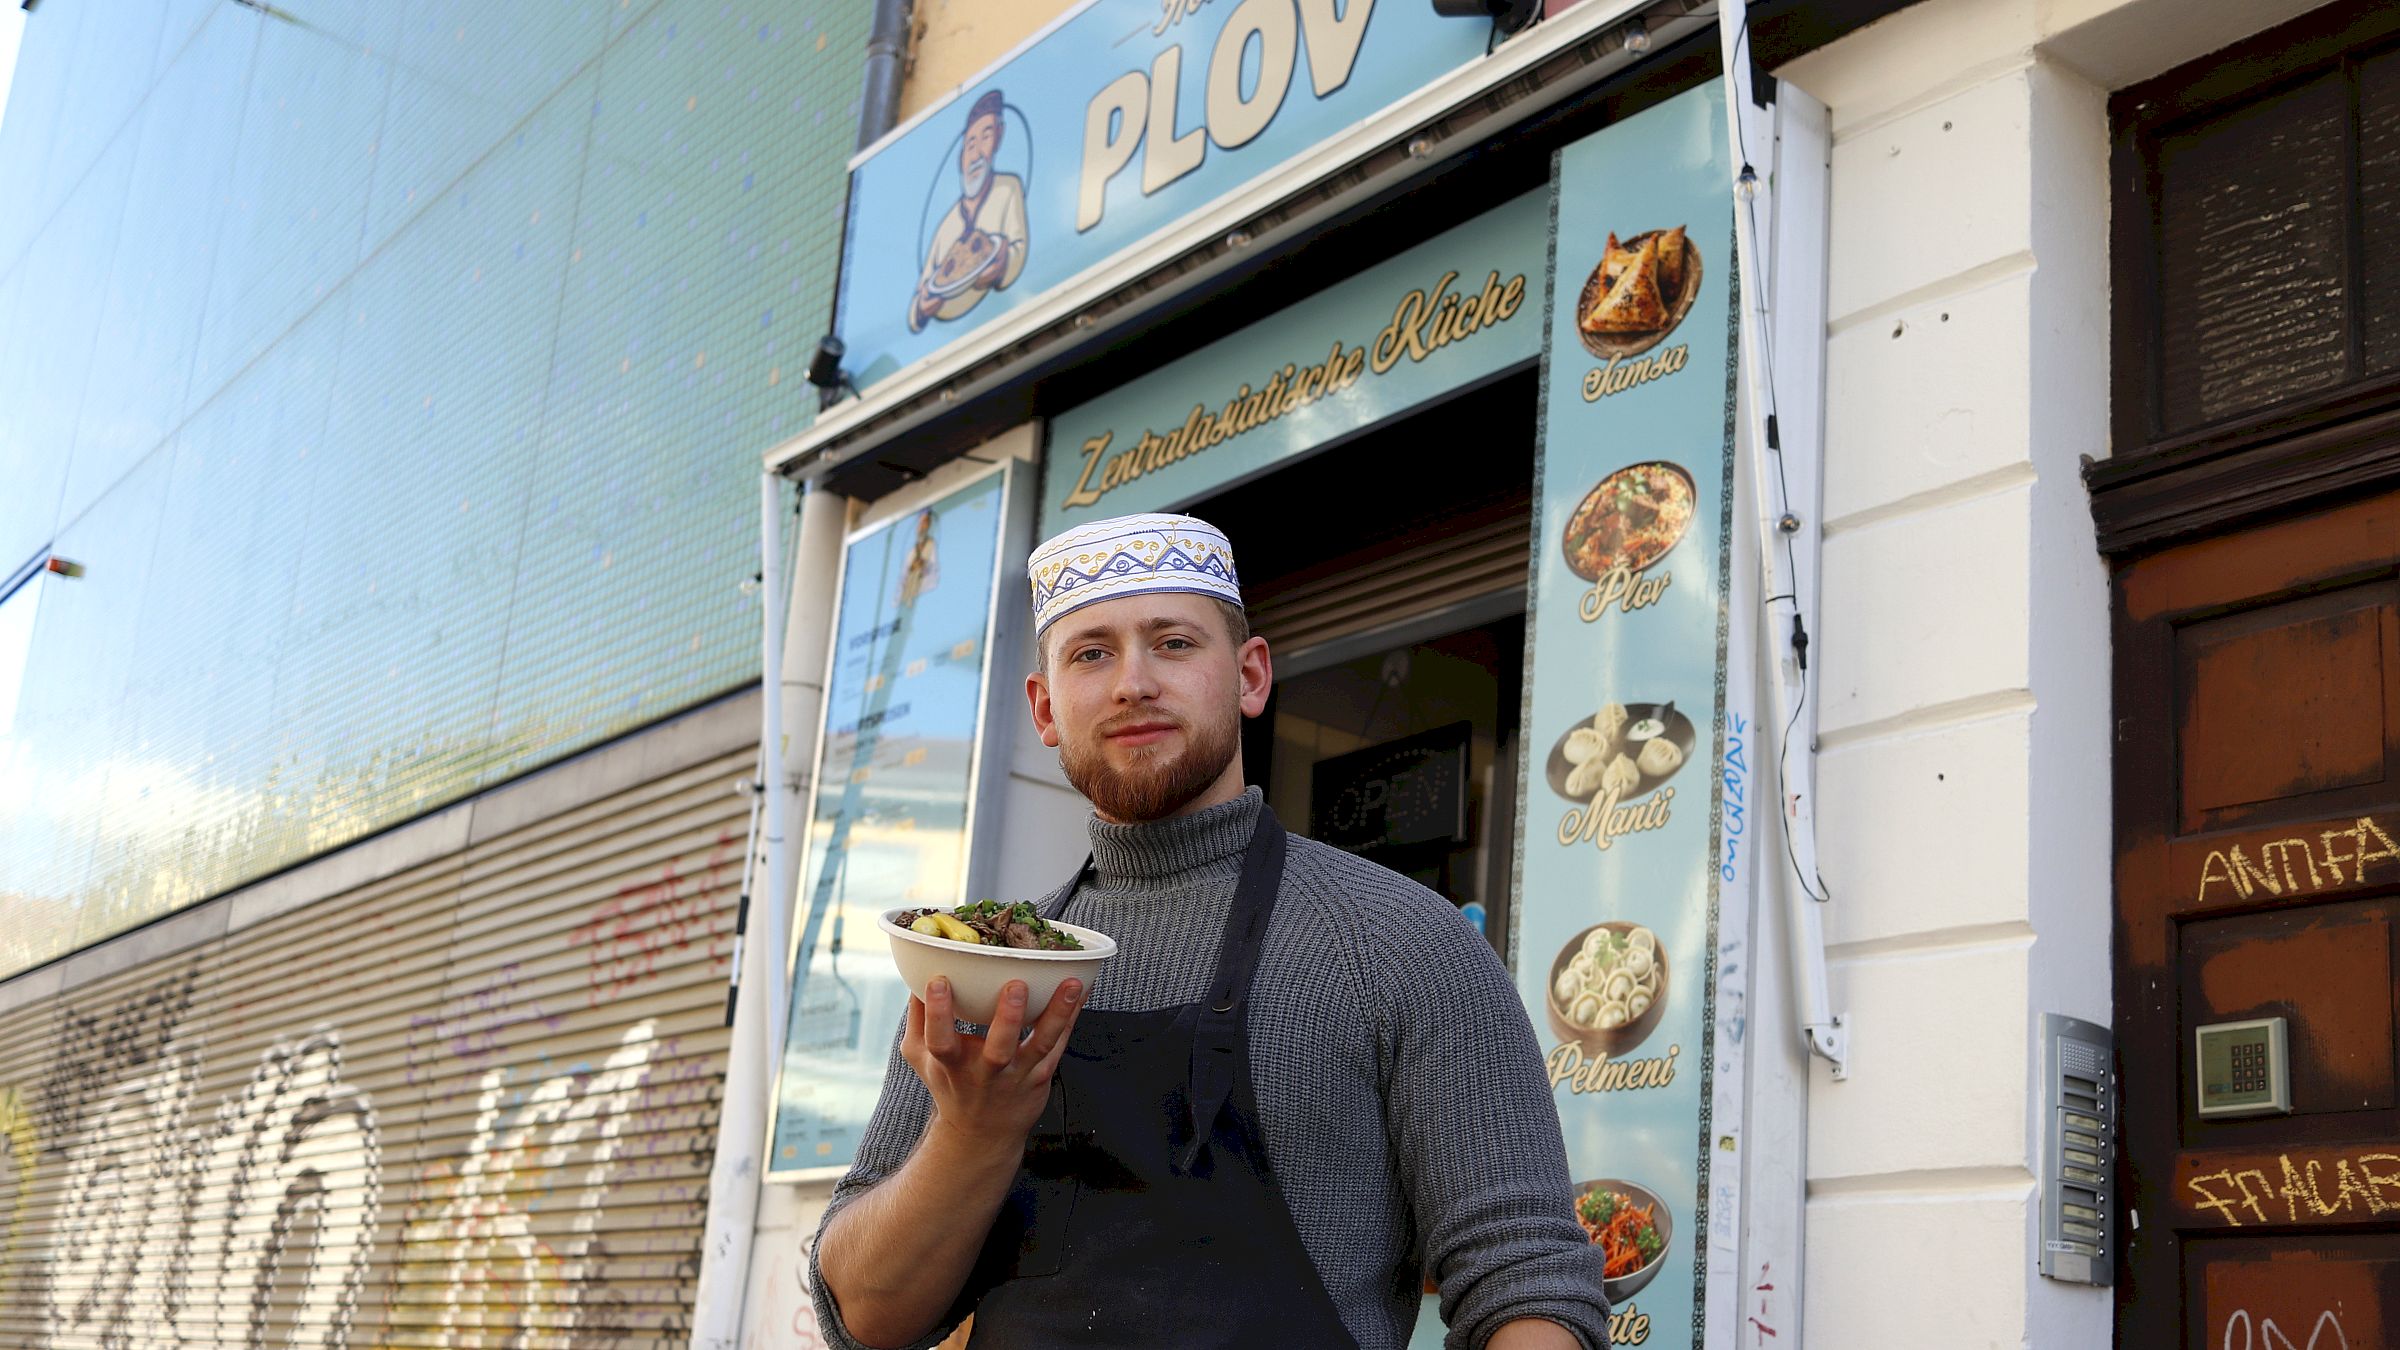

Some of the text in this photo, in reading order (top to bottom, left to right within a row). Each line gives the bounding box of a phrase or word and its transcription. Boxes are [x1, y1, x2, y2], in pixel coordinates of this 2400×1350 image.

[1075, 0, 1375, 233] PLOV
[1061, 269, 1526, 510] Zentralasiatische Küche
[1581, 341, 1688, 402] Samsa
[1579, 562, 1672, 623] Plov
[1557, 787, 1675, 850] Manti
[1547, 1040, 1680, 1095] Pelmeni
[1606, 1303, 1650, 1346] ate
